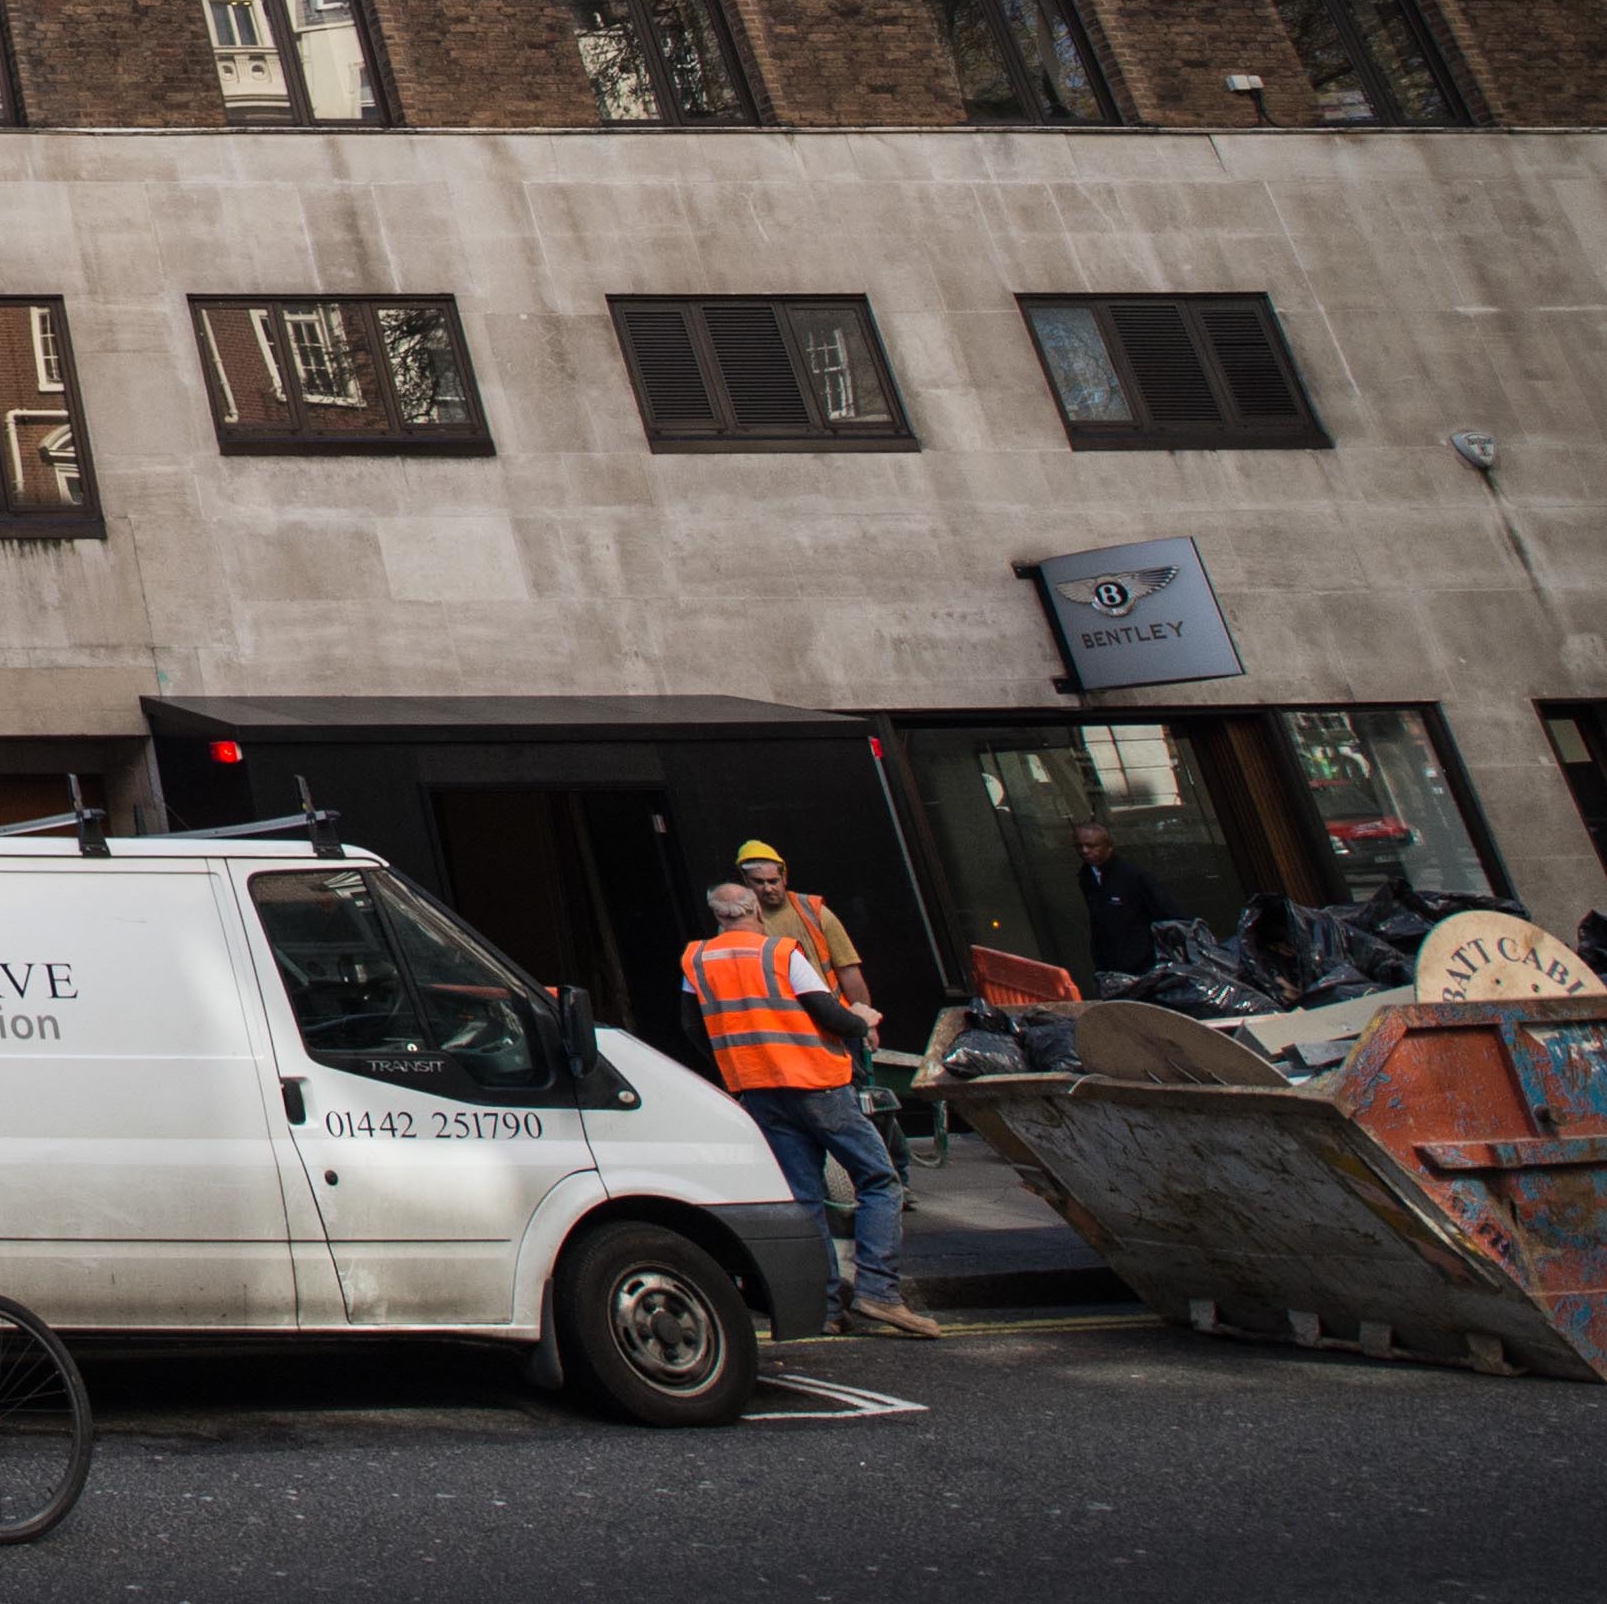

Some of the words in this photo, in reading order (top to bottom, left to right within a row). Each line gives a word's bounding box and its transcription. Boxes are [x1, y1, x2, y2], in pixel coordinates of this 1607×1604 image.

[1081, 621, 1184, 649] BENTLEY
[366, 1060, 445, 1073] TRANSIT
[325, 1110, 417, 1138] 01442
[431, 1111, 543, 1140] 251790
